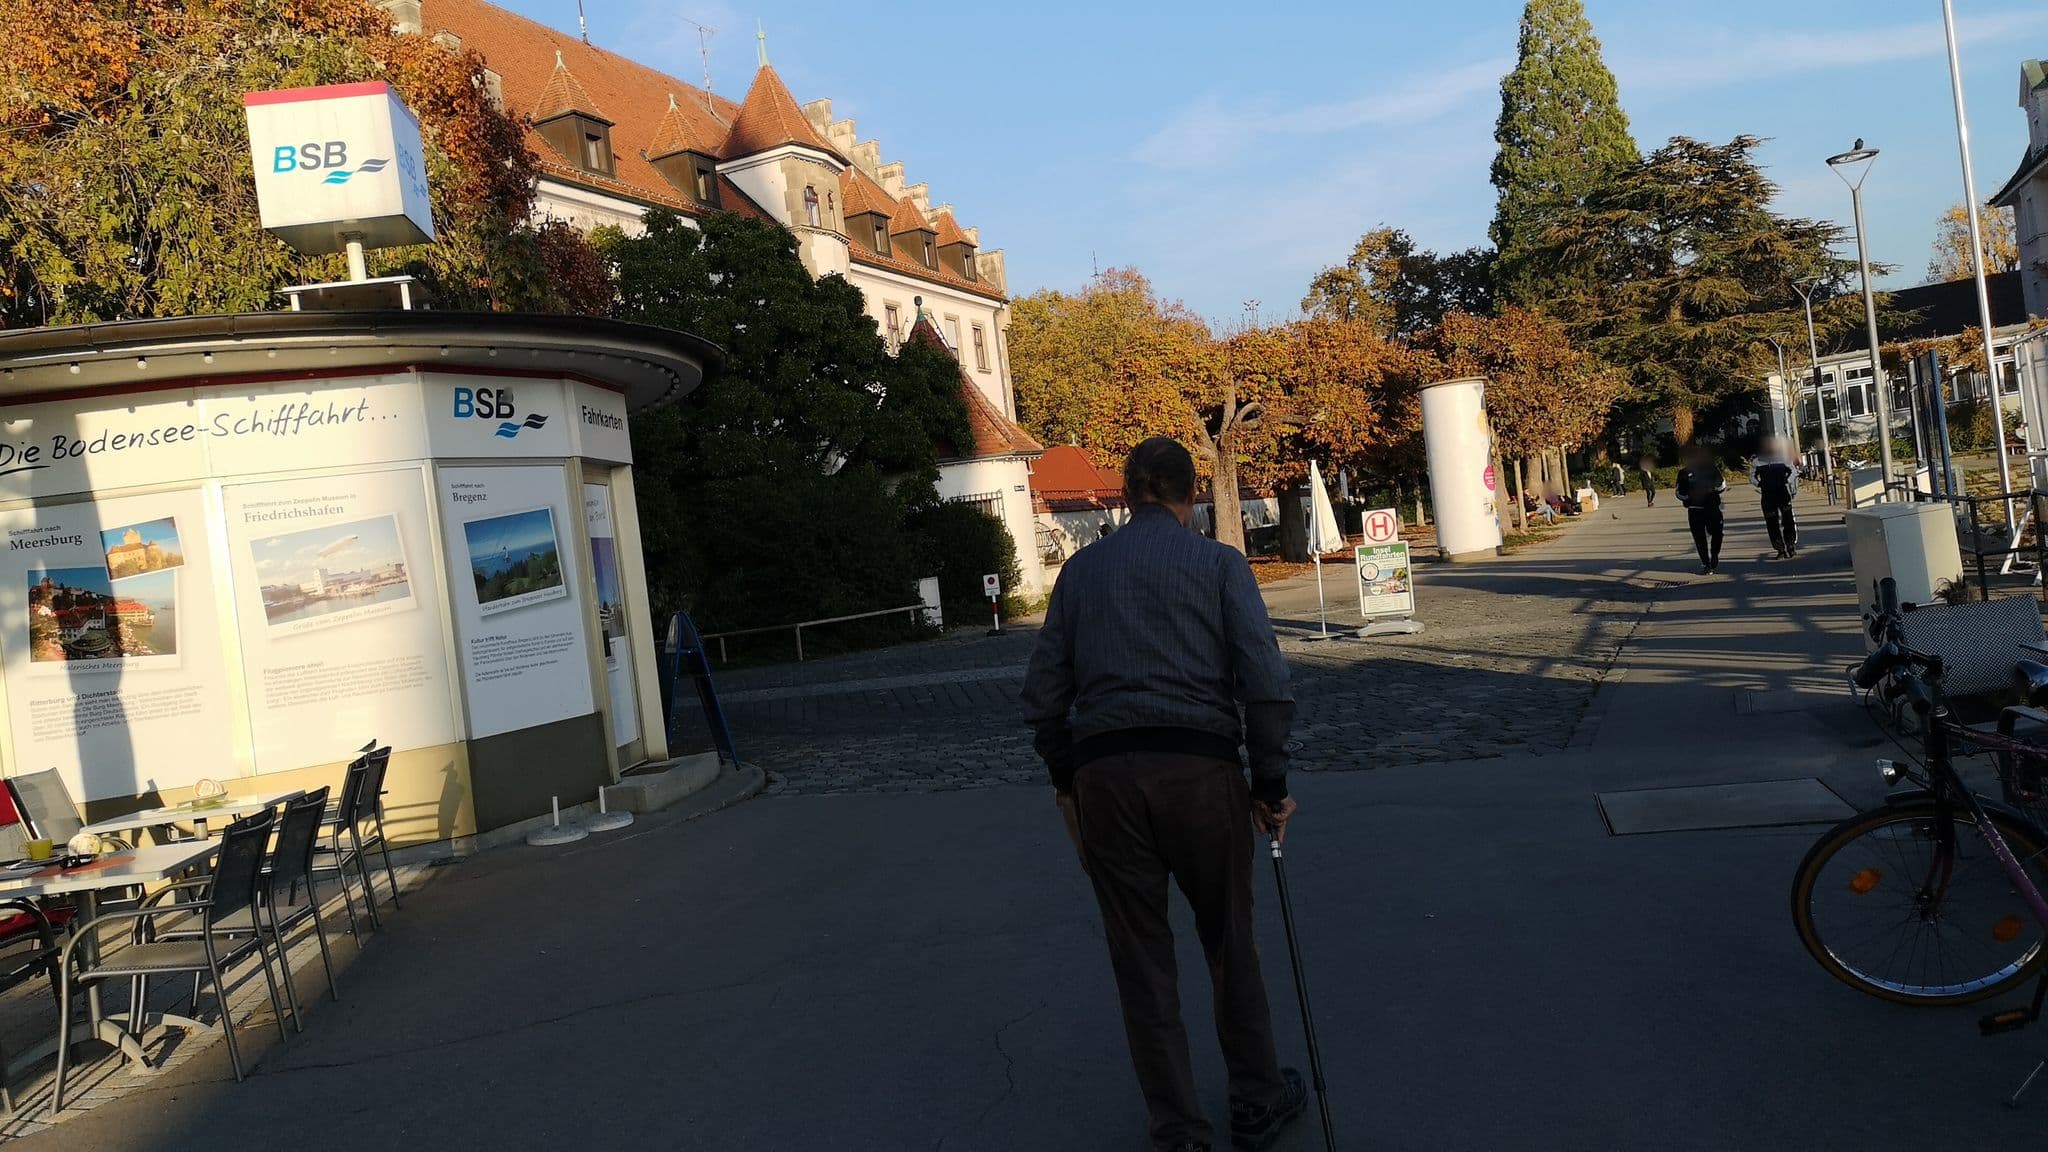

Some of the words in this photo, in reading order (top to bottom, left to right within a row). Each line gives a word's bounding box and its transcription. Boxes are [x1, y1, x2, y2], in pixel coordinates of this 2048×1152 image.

[273, 141, 348, 174] BSB
[453, 387, 515, 420] BSB
[581, 405, 624, 432] Fahrkarten
[0, 441, 40, 467] Die
[452, 492, 488, 504] Bregenz
[244, 504, 345, 523] Friedrichshafen
[1371, 516, 1389, 538] H
[10, 533, 83, 551] Meersburg
[1373, 546, 1391, 555] Insel
[1360, 550, 1406, 562] Rundfahrten
